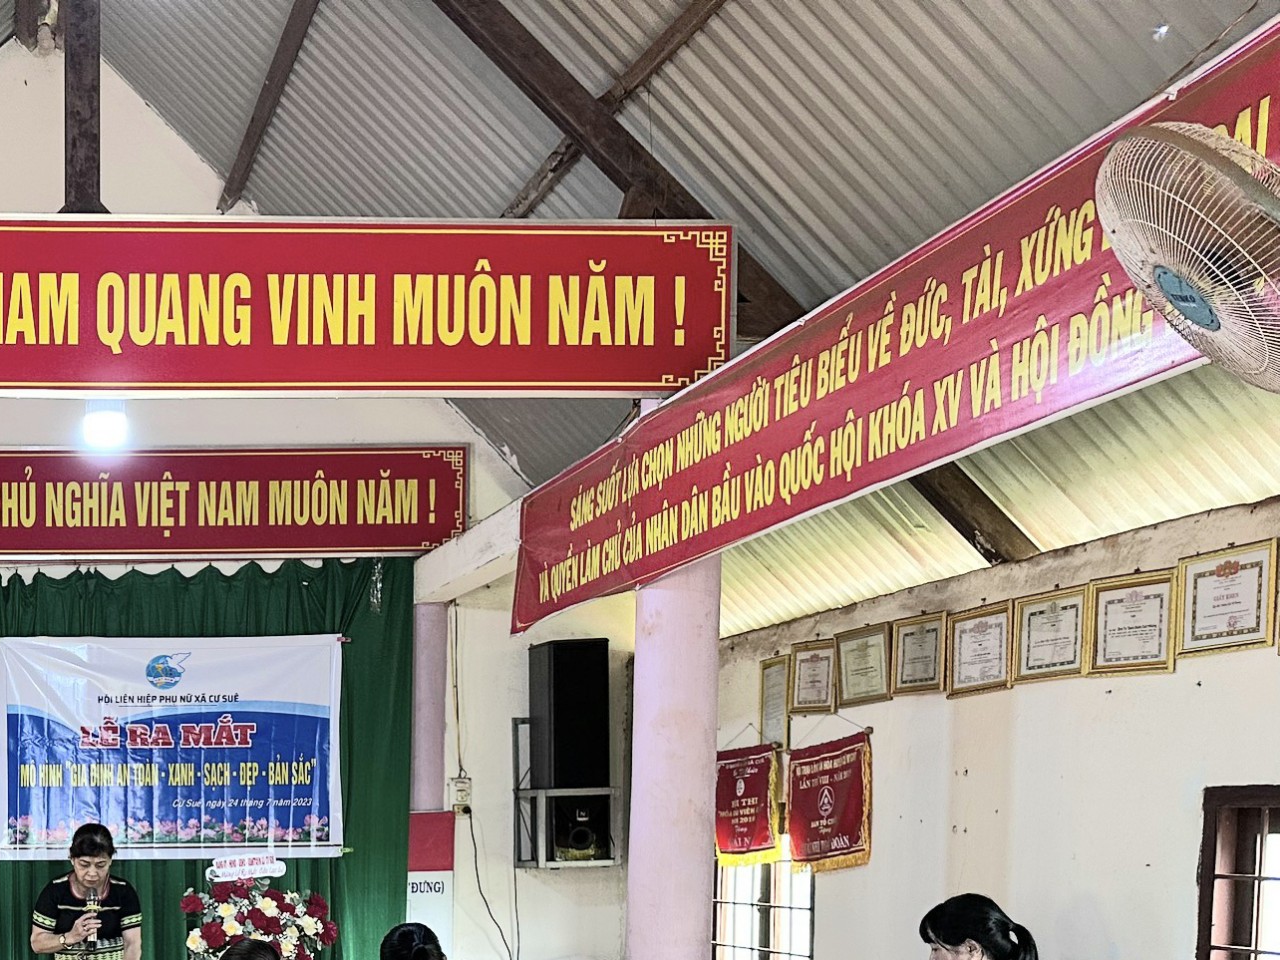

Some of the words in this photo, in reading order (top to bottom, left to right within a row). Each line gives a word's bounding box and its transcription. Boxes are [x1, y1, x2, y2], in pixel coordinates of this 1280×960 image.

[95, 271, 252, 355] QUANG
[267, 273, 377, 346] VINH
[393, 259, 532, 347] MUÔN
[548, 260, 656, 347] NĂM
[673, 276, 686, 347] !
[570, 485, 595, 531] SÁNG
[595, 459, 622, 518] SUỐT
[621, 453, 640, 507] LỰA
[640, 437, 674, 491] CHỌN
[676, 410, 722, 473] NHỮNG
[724, 375, 770, 449] NGƯỜI
[773, 354, 814, 422] TIÊU
[816, 312, 863, 400] BIỂU
[867, 290, 898, 374] VỀ
[899, 276, 952, 358] ĐỨC,
[961, 243, 1008, 325] TÀI,
[1015, 199, 1096, 298] XỨNG
[550, 543, 579, 604] QUYỀN
[579, 539, 600, 586] LÀM
[601, 519, 622, 576] CHỦ
[622, 511, 643, 566] CỦA
[645, 499, 679, 557] NHÂN
[681, 485, 709, 541] DÂN
[711, 462, 741, 529] BẦU
[744, 453, 776, 514] VÀO
[778, 420, 826, 506] QUỐC
[830, 408, 864, 483] HỘI
[867, 380, 926, 463] KHÓA
[931, 369, 964, 437] XV
[970, 338, 1002, 419] VÀ
[1011, 314, 1061, 405] HỘI
[1068, 270, 1154, 378] ĐỒNG
[45, 472, 127, 528] NGHĨA
[134, 471, 190, 538] VIỆT
[198, 480, 260, 527] NAM
[268, 470, 348, 527] MUÔN
[357, 469, 419, 526] NĂM
[428, 478, 437, 524] !
[97, 693, 113, 705] HỘI
[115, 693, 135, 704] LIÊN
[136, 693, 158, 707] HIỆP
[179, 693, 194, 703] NỮ
[194, 692, 207, 703] XÃ
[222, 692, 240, 703] SUÊ
[126, 724, 174, 748] RA
[180, 714, 256, 748] MẮT
[20, 759, 36, 787] MÔ
[38, 759, 63, 787] HÌNH
[89, 759, 114, 787] ĐÌNH
[116, 763, 131, 787] AN
[133, 758, 159, 787] TOÀN
[167, 763, 195, 786] XANH
[203, 763, 231, 791] SẠCH
[239, 762, 259, 791] ĐẸP
[268, 753, 289, 785] BẢN
[228, 799, 239, 808] 24
[292, 798, 313, 807] 2023
